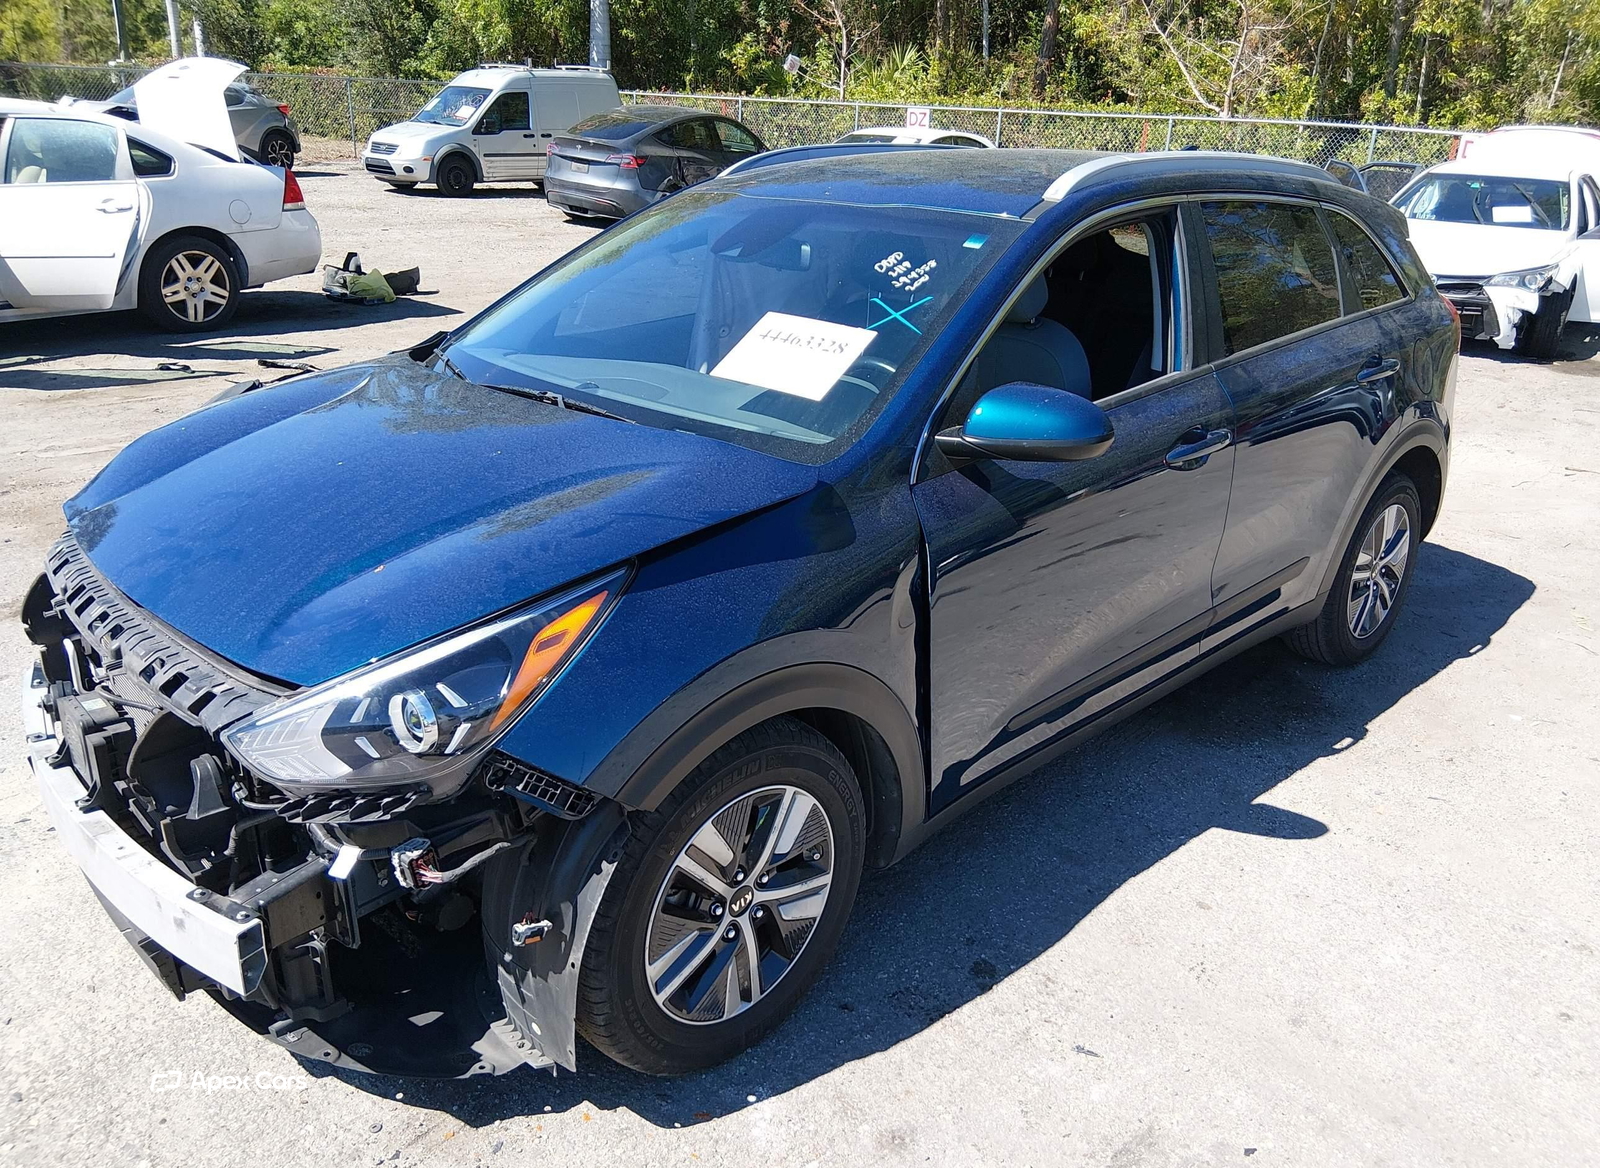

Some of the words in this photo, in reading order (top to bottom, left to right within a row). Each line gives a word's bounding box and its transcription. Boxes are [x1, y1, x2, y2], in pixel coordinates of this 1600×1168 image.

[909, 111, 927, 127] DZ
[828, 769, 857, 818] ENERGY
[731, 891, 752, 912] KIA
